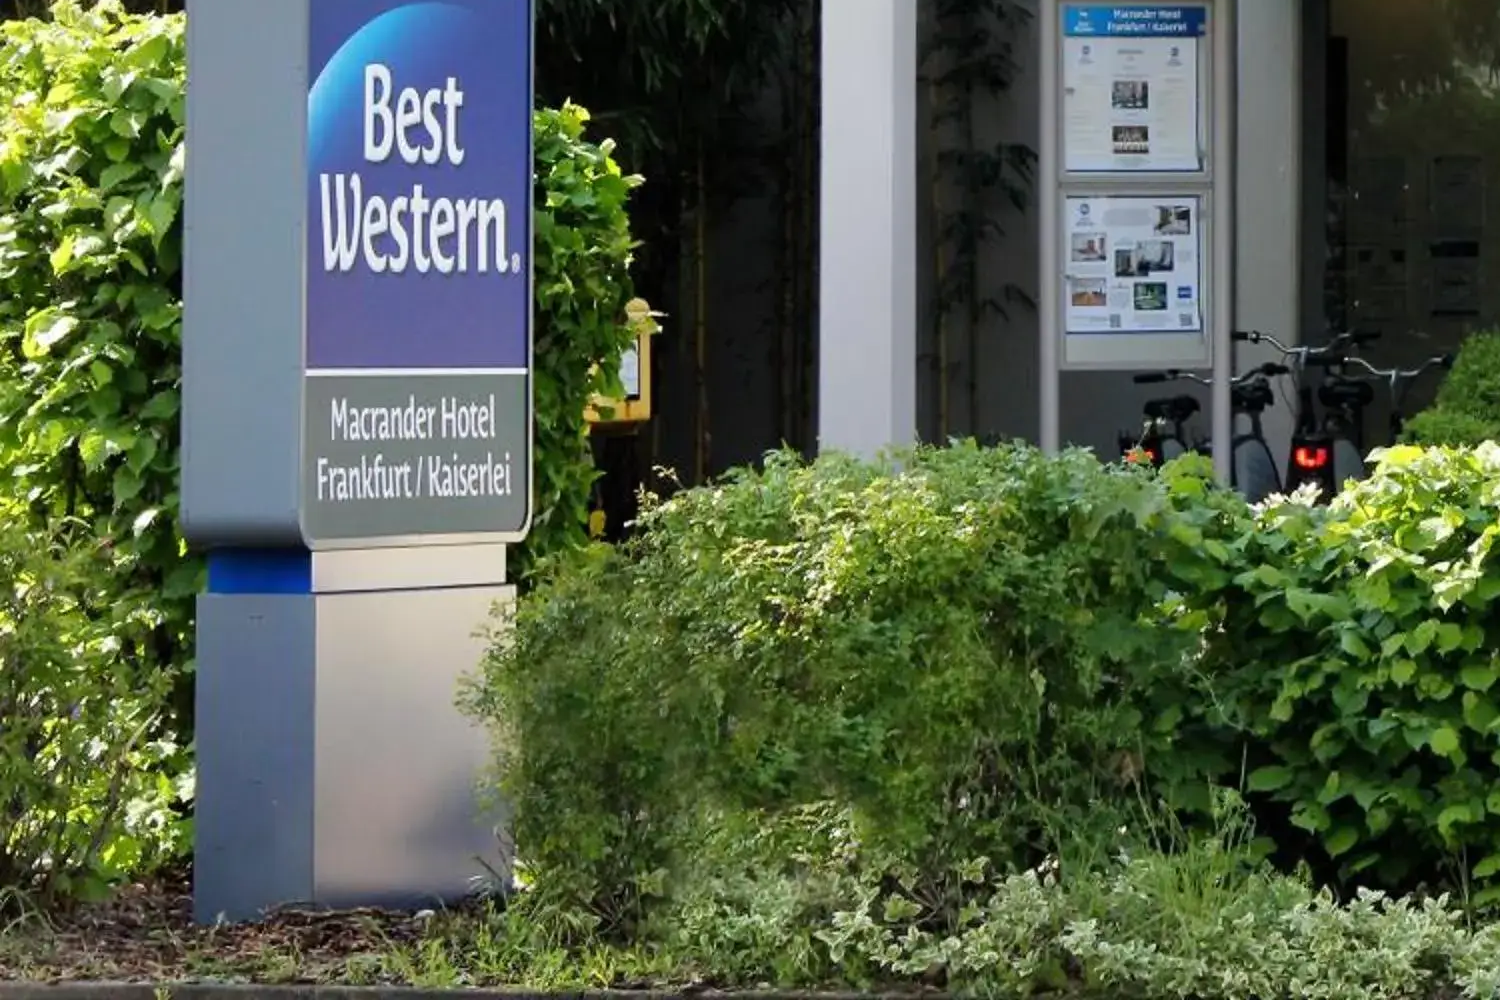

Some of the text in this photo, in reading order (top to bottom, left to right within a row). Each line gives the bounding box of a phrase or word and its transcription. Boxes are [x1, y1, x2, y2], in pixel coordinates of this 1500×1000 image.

[363, 63, 465, 165] Best
[330, 393, 496, 443] Macrander Hotel
[317, 450, 512, 501] Frankfurt / Kaiserlei
